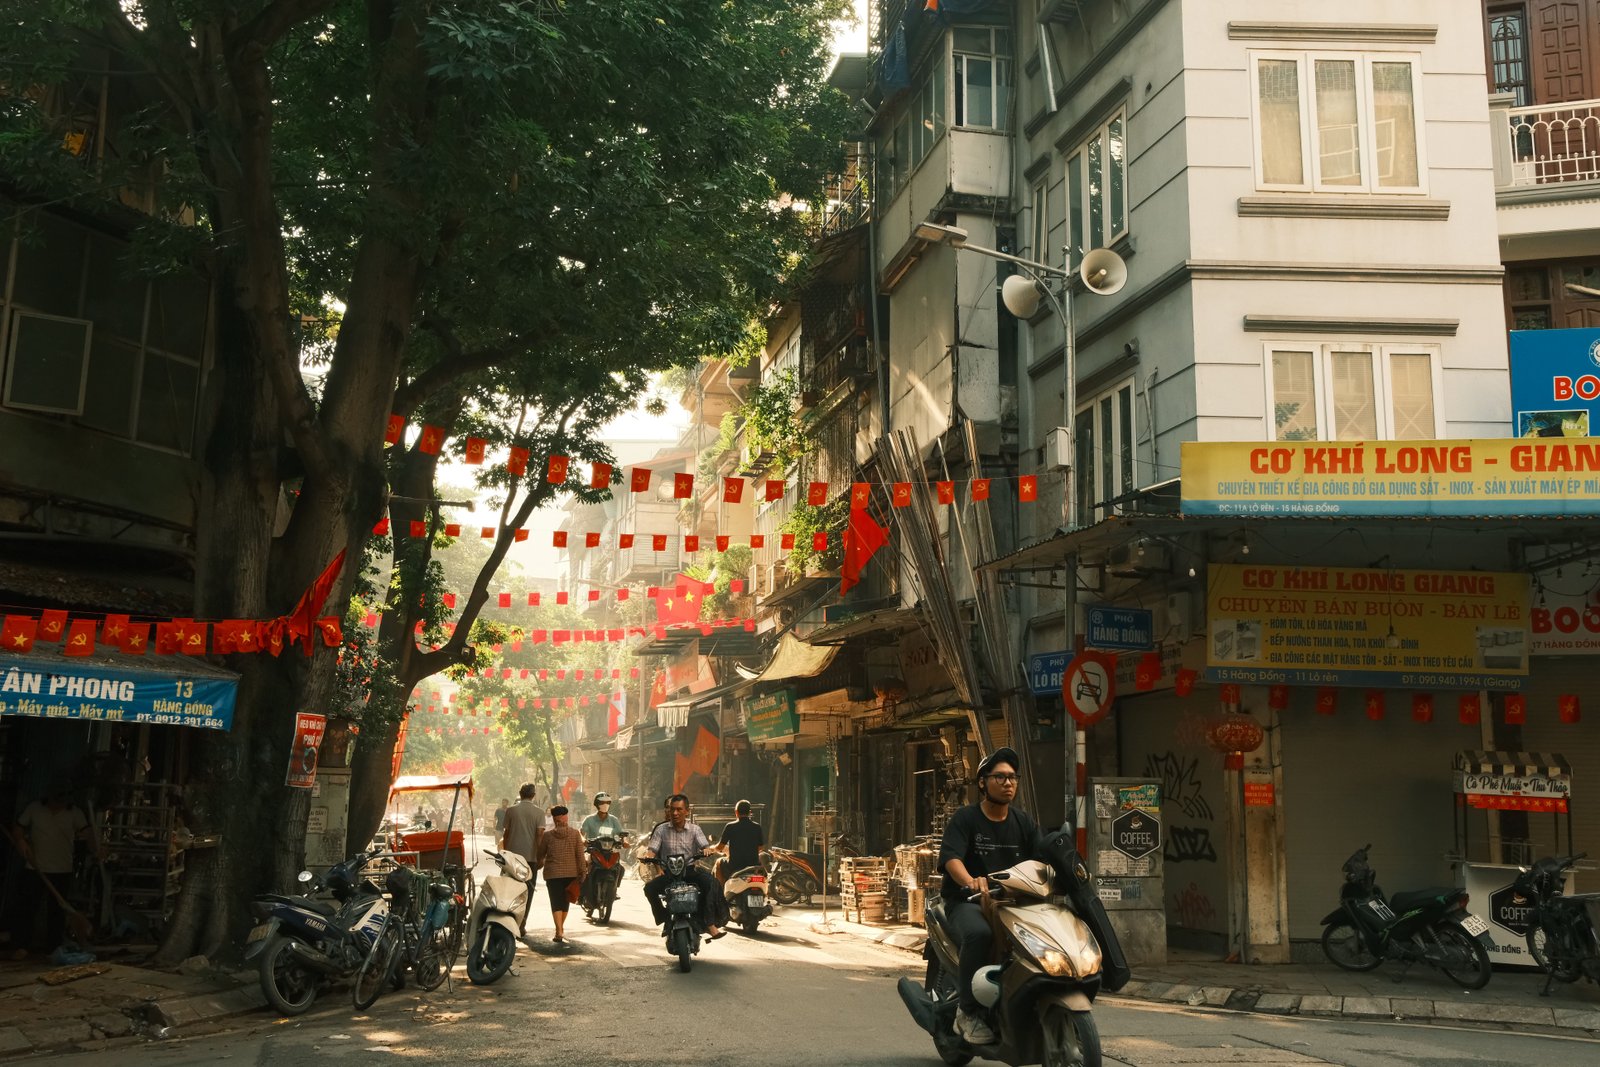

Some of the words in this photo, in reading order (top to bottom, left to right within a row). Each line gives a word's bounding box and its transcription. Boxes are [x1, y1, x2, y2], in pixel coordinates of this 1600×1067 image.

[1250, 447, 1296, 474] CƠ
[1304, 442, 1364, 474] KHÍ
[1375, 446, 1472, 474] LONG
[1217, 479, 1255, 496] CHUYÊN
[1258, 477, 1285, 495] THIẾT
[1287, 477, 1300, 495] KẾ
[1303, 481, 1319, 496] GIA
[1322, 478, 1350, 496] CÔNG
[1369, 481, 1386, 496] GIA
[1389, 481, 1417, 499] DỤNG
[1420, 476, 1440, 496] SẮT
[1450, 481, 1474, 496] INOX
[1484, 475, 1507, 496] SẢN
[1509, 474, 1537, 495] XUẤT
[1540, 476, 1563, 494] MÁY
[1567, 476, 1581, 494] ÉP
[1249, 502, 1259, 512] LÒ
[1282, 504, 1290, 512] 15
[1291, 502, 1314, 513] HÀNG
[1243, 569, 1278, 588] CƠ
[1283, 568, 1329, 590] KHÍ
[1335, 572, 1406, 592] LONG
[1414, 574, 1495, 595] GIANG
[1218, 595, 1308, 614] CHUYÊN
[1314, 597, 1358, 616] BÁN
[1364, 599, 1425, 617] BUÔN
[1442, 601, 1487, 619] BÁN
[1093, 624, 1120, 642] HÀNG
[1314, 636, 1332, 648] THAN
[1544, 638, 1573, 649] HÀNG
[1575, 637, 1600, 649] ĐỒN
[1049, 657, 1065, 667] PHỐ
[1403, 656, 1421, 667] INOX
[1423, 656, 1441, 668] THEO
[1034, 670, 1048, 688] LÒ
[1051, 669, 1065, 687] RÈ
[1217, 669, 1228, 680] 15
[1295, 671, 1305, 681] 11
[1483, 676, 1522, 689] (Giang)
[0, 666, 42, 695] ÂN
[48, 674, 136, 702] PHONG
[175, 680, 194, 699] 13
[153, 698, 182, 714] HÀNG
[1465, 775, 1478, 790] Cà
[1479, 775, 1500, 791] Phê
[1500, 776, 1522, 792] Muối
[1529, 778, 1546, 793] Thu
[1547, 778, 1568, 793] Thảo
[1120, 832, 1152, 846] COFFEE
[1500, 907, 1535, 921] COFF
[304, 917, 327, 932] YAMAHA
